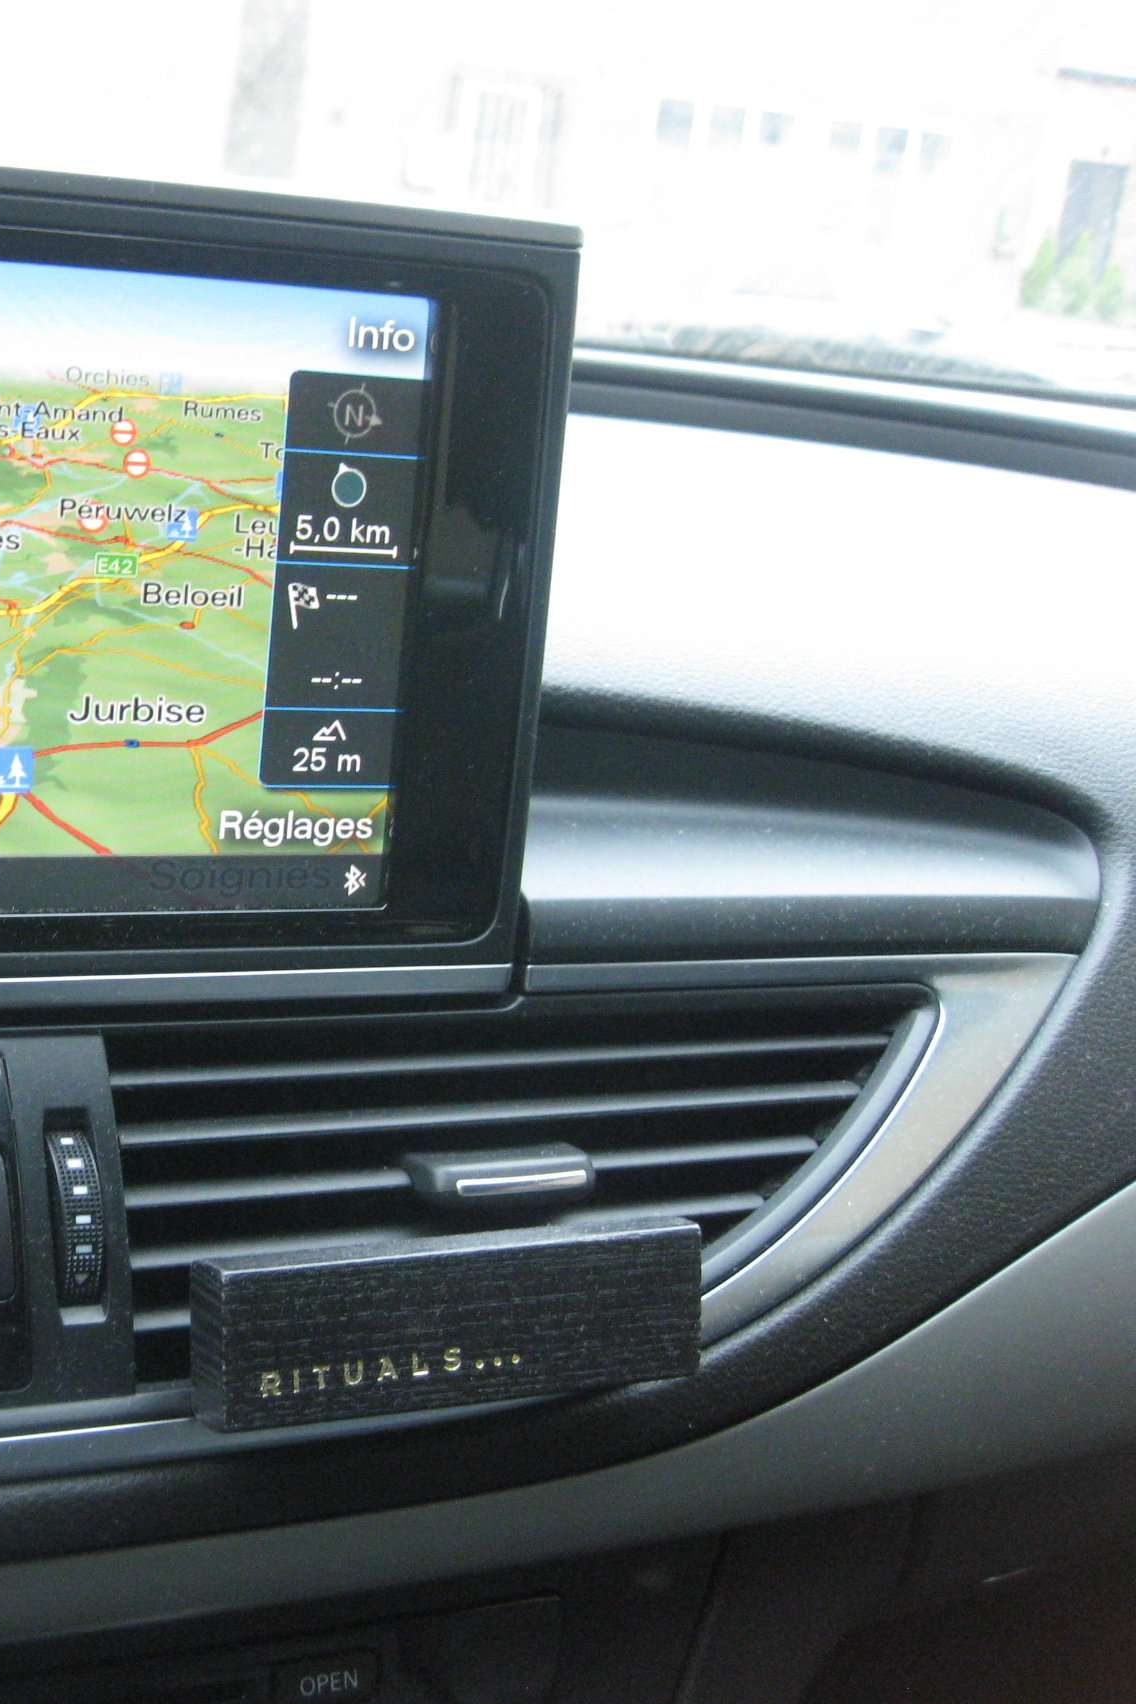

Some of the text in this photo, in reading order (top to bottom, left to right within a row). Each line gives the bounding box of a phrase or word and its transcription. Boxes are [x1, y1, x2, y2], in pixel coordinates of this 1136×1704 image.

[347, 316, 416, 352] Info
[66, 366, 150, 387] Orchies
[184, 401, 262, 422] Rumes
[59, 498, 187, 524] Péruwelz
[295, 514, 391, 544] 5,0 km
[96, 556, 134, 575] E42
[142, 583, 243, 608] Beloeil
[69, 696, 206, 723] Jurbise
[292, 748, 362, 772] 25 m
[218, 809, 374, 847] Réglages
[150, 860, 332, 894] Soignies
[299, 1667, 359, 1697] OPEN
